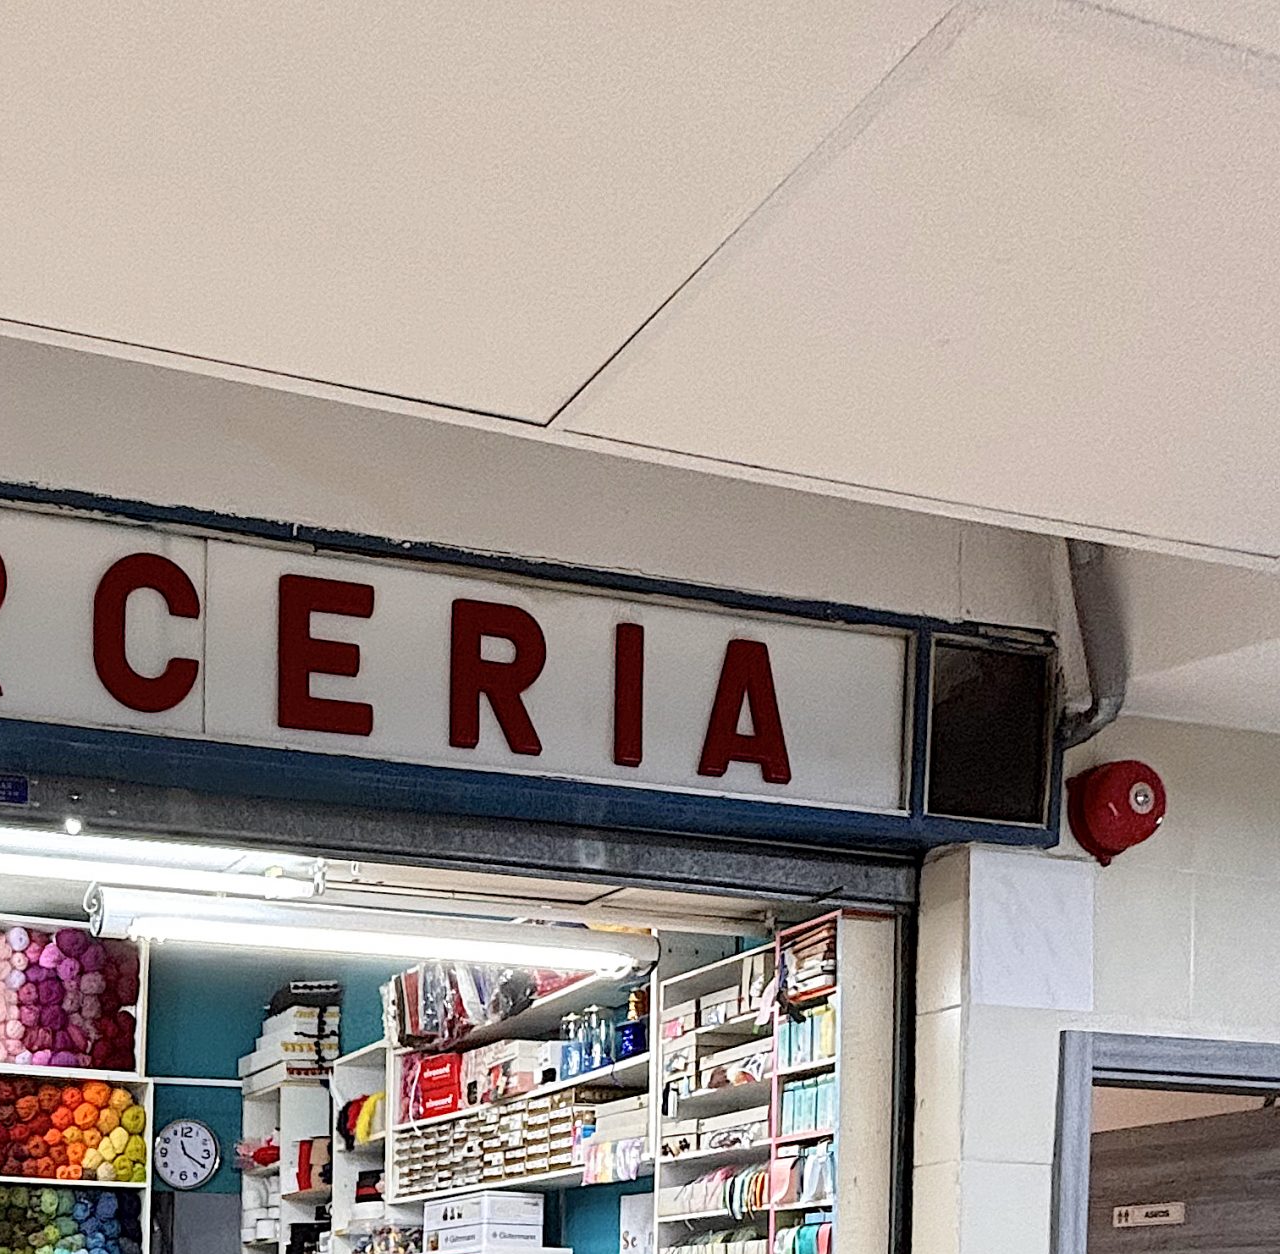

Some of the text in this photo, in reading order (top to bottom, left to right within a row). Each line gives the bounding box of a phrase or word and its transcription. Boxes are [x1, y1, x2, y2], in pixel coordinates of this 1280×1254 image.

[181, 1126, 193, 1138] 12
[159, 1147, 168, 1157] 9
[201, 1149, 211, 1159] 3
[179, 1170, 188, 1181] 6
